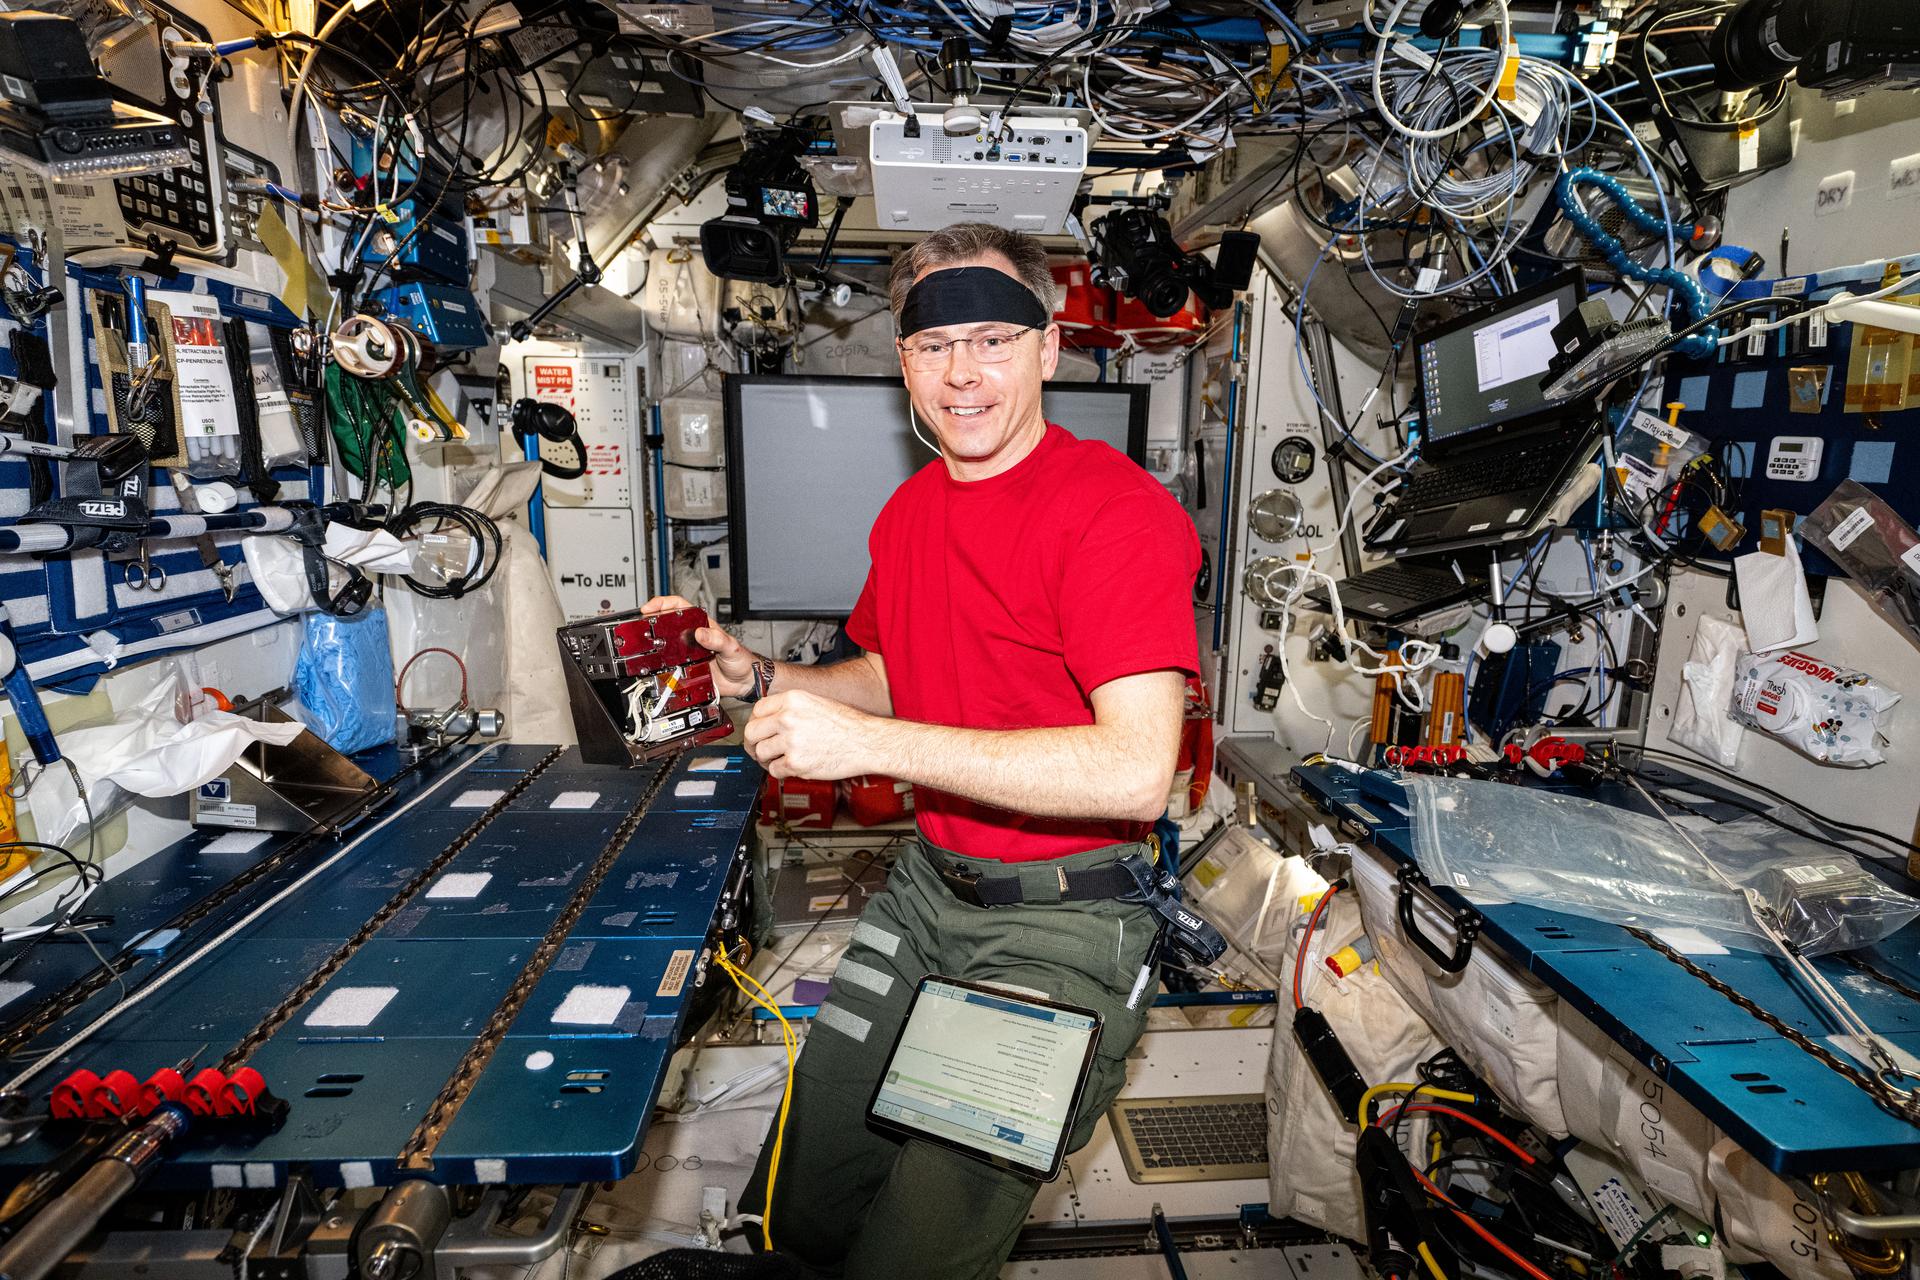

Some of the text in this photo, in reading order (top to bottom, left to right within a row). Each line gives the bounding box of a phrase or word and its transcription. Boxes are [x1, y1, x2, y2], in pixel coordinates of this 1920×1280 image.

[1818, 186, 1848, 207] DRY
[540, 367, 568, 375] WATER
[536, 377, 571, 385] MIST PFE
[78, 500, 124, 517] PETZL
[574, 573, 626, 587] To JEM
[1776, 655, 1838, 683] HUGGIES
[1767, 679, 1787, 696] Trash
[1177, 910, 1203, 931] PETZL
[1640, 1079, 1667, 1158] 5054
